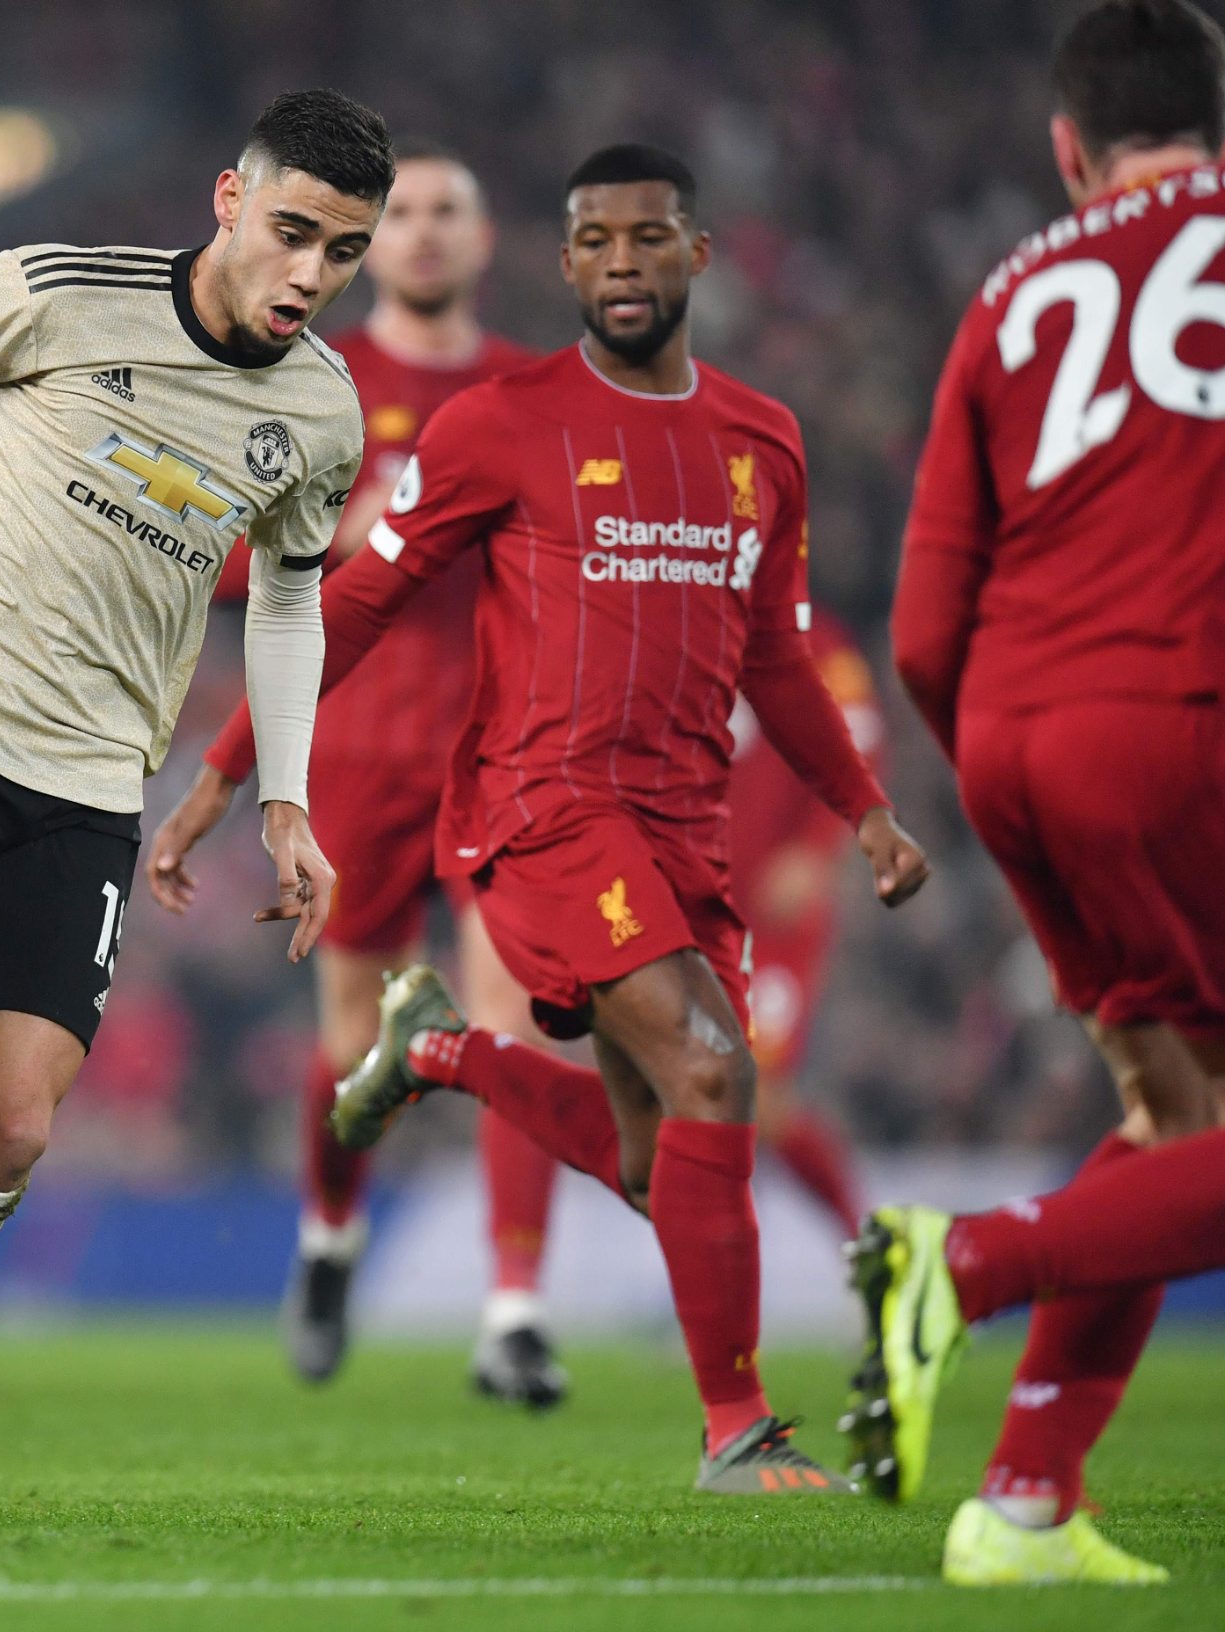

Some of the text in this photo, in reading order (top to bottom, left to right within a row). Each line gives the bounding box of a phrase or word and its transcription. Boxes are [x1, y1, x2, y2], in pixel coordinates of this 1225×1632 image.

[982, 166, 1225, 308] ROBERTS
[996, 213, 1225, 491] 26
[91, 374, 136, 403] adidas
[253, 424, 289, 453] MANCHESTER
[250, 462, 276, 480] UNITED
[66, 480, 215, 574] CHEVROLET
[594, 515, 732, 551] Standard
[582, 551, 729, 587] Chartered
